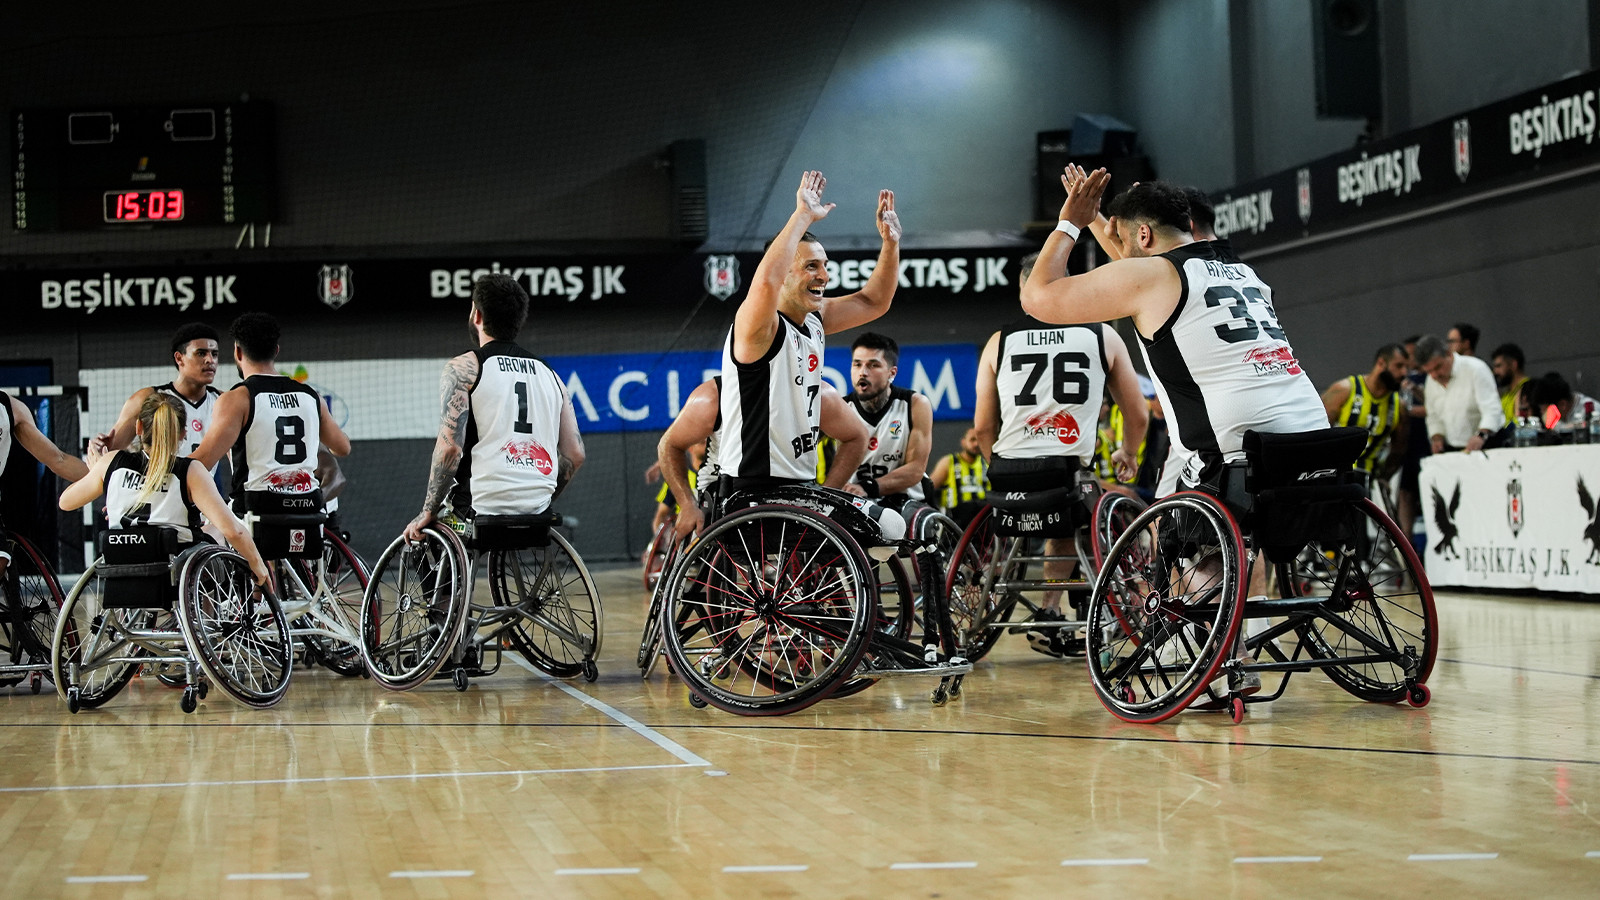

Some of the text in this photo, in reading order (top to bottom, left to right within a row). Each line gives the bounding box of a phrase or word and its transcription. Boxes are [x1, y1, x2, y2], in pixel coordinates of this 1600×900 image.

[116, 191, 182, 220] 15:03
[591, 265, 626, 300] JK
[974, 257, 1009, 292] JK
[41, 272, 237, 314] BEŞİKTAŞ JK
[1204, 286, 1289, 343] 33
[497, 357, 536, 375] BROWN
[1011, 352, 1090, 406] 76
[269, 394, 300, 409] AYHAN
[514, 381, 532, 434] 1
[807, 385, 820, 417] 7
[275, 416, 307, 465] 8
[1024, 427, 1080, 438] MARCA
[506, 455, 553, 469] MARCA
[282, 499, 314, 507] EXTRA
[1005, 492, 1027, 500] MX
[1002, 514, 1014, 527] 76
[109, 534, 147, 544] EXTRA
[1465, 541, 1537, 582] BEŞİKTAŞ
